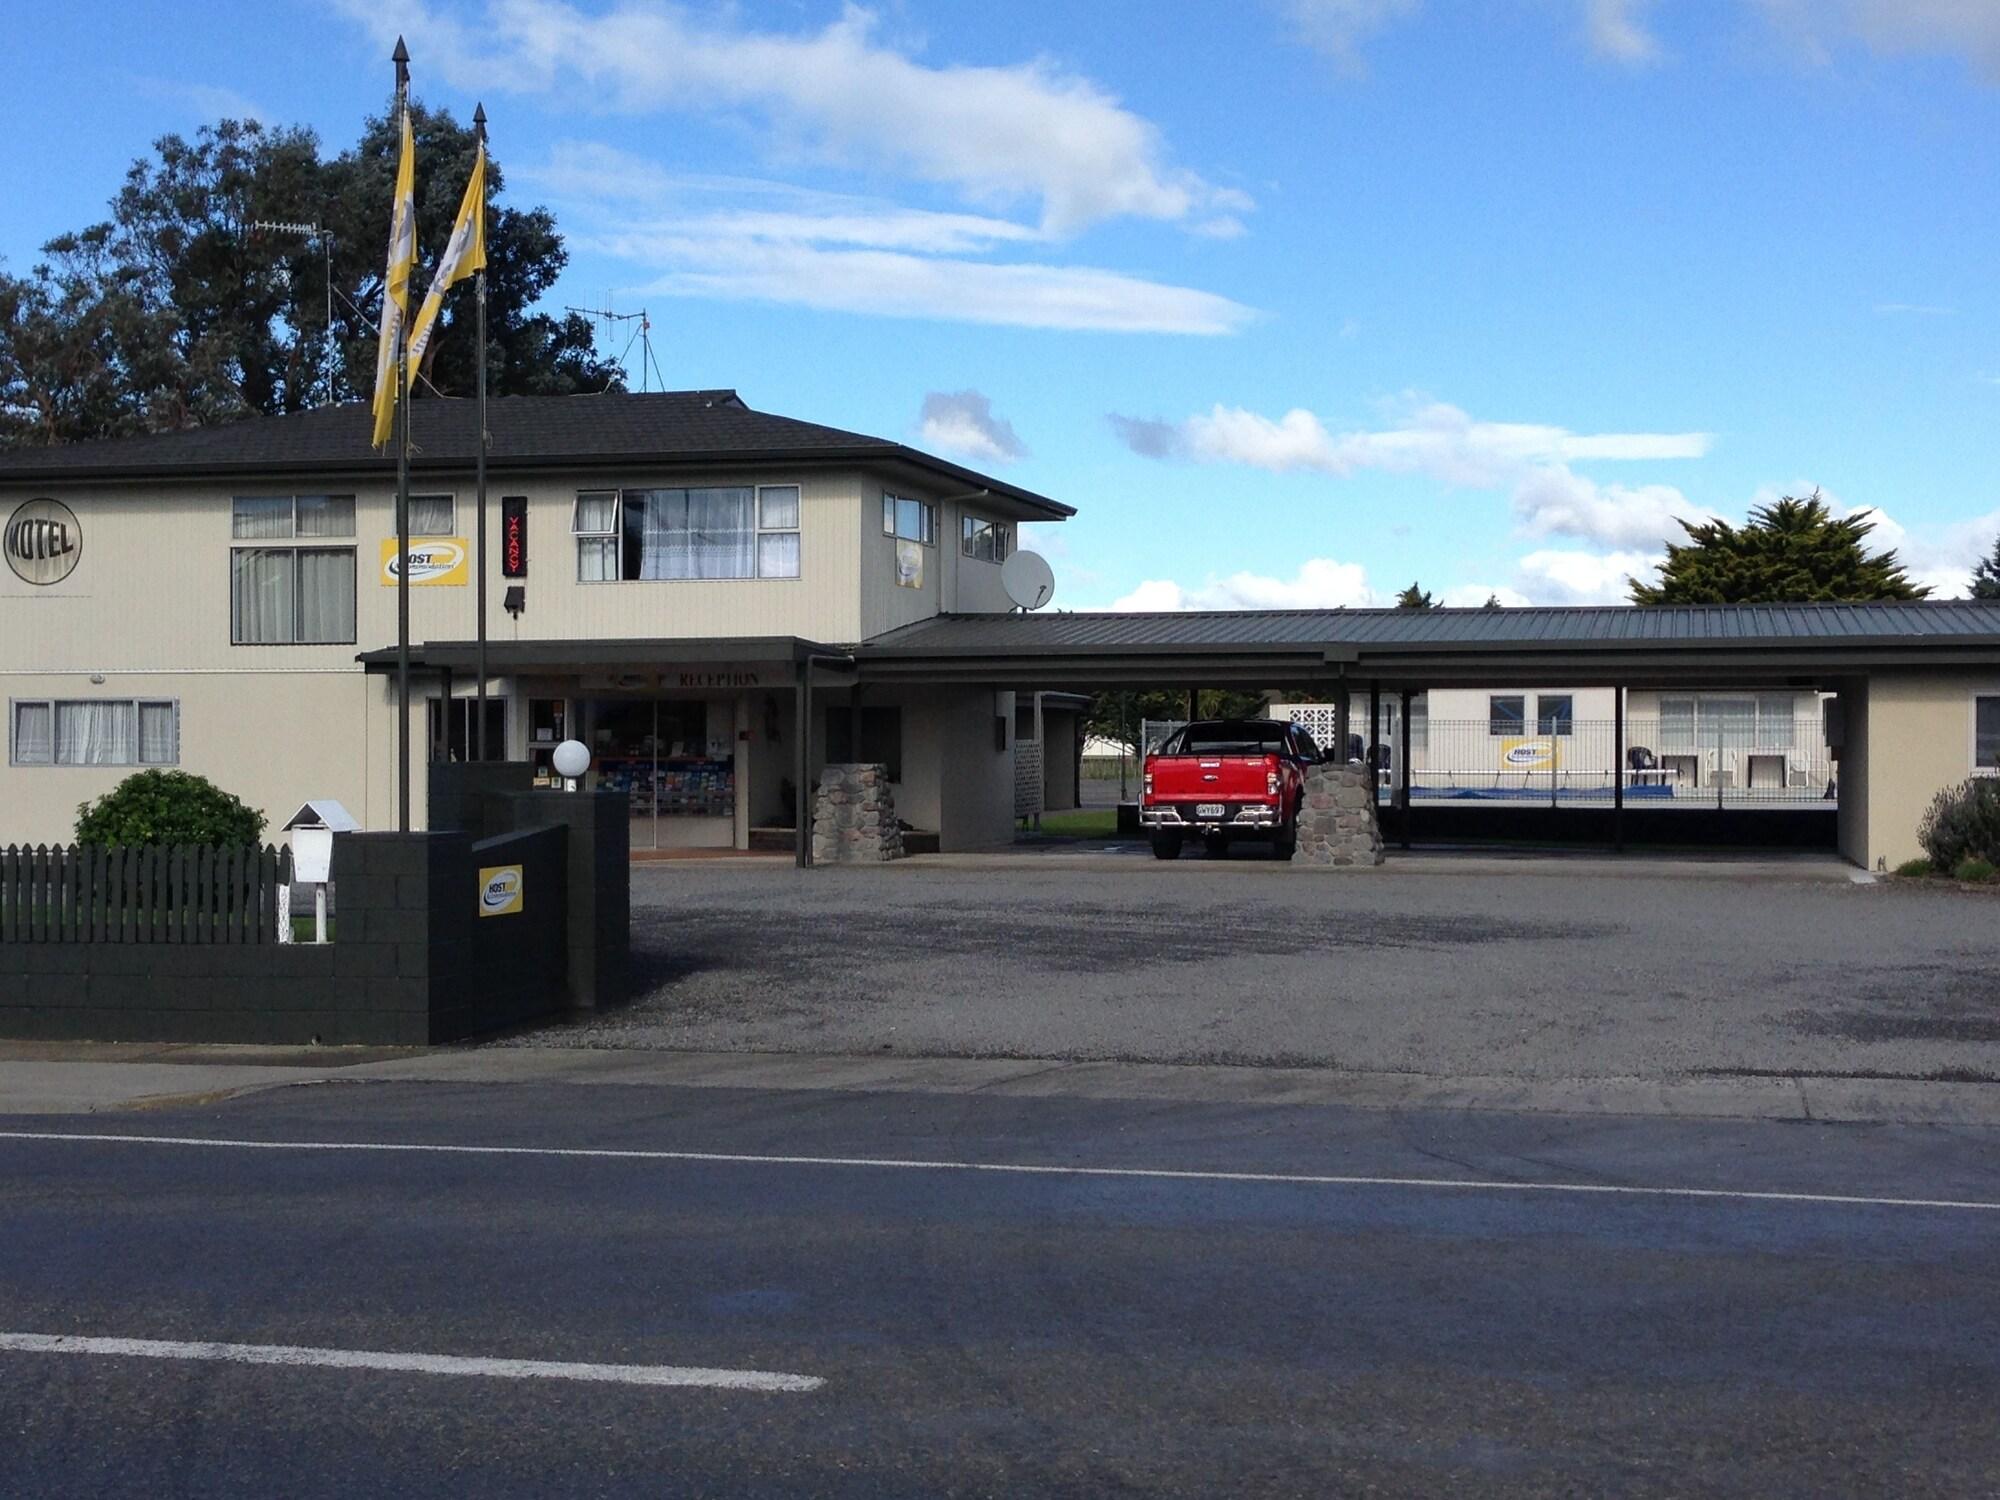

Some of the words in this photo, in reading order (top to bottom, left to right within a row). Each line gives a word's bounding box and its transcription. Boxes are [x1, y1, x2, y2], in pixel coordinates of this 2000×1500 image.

[8, 519, 74, 559] MOTEL
[508, 516, 520, 573] VACANCY
[406, 554, 433, 564] OST
[678, 671, 760, 687] RECEPTION
[488, 882, 506, 893] HOST
